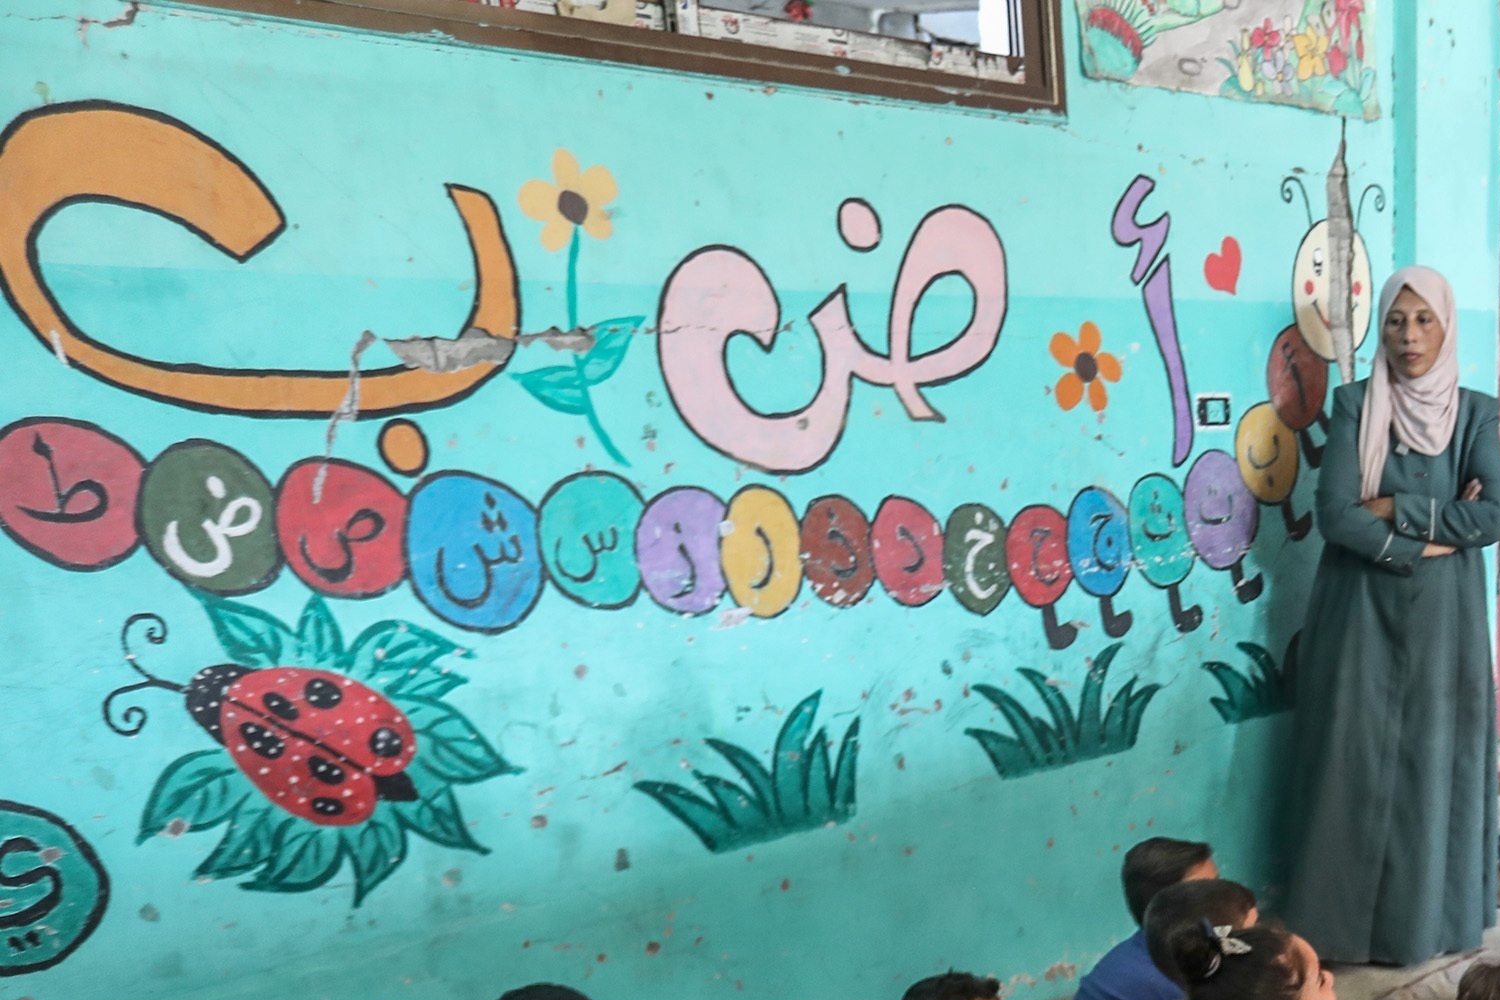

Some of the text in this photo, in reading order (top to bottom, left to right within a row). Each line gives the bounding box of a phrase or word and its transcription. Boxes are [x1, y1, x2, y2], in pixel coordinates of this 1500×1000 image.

[15, 430, 110, 524] ط
[162, 475, 263, 578] ض
[299, 508, 388, 583] ص
[435, 492, 525, 610] ش
[553, 523, 619, 583] س
[963, 512, 998, 600] خ
